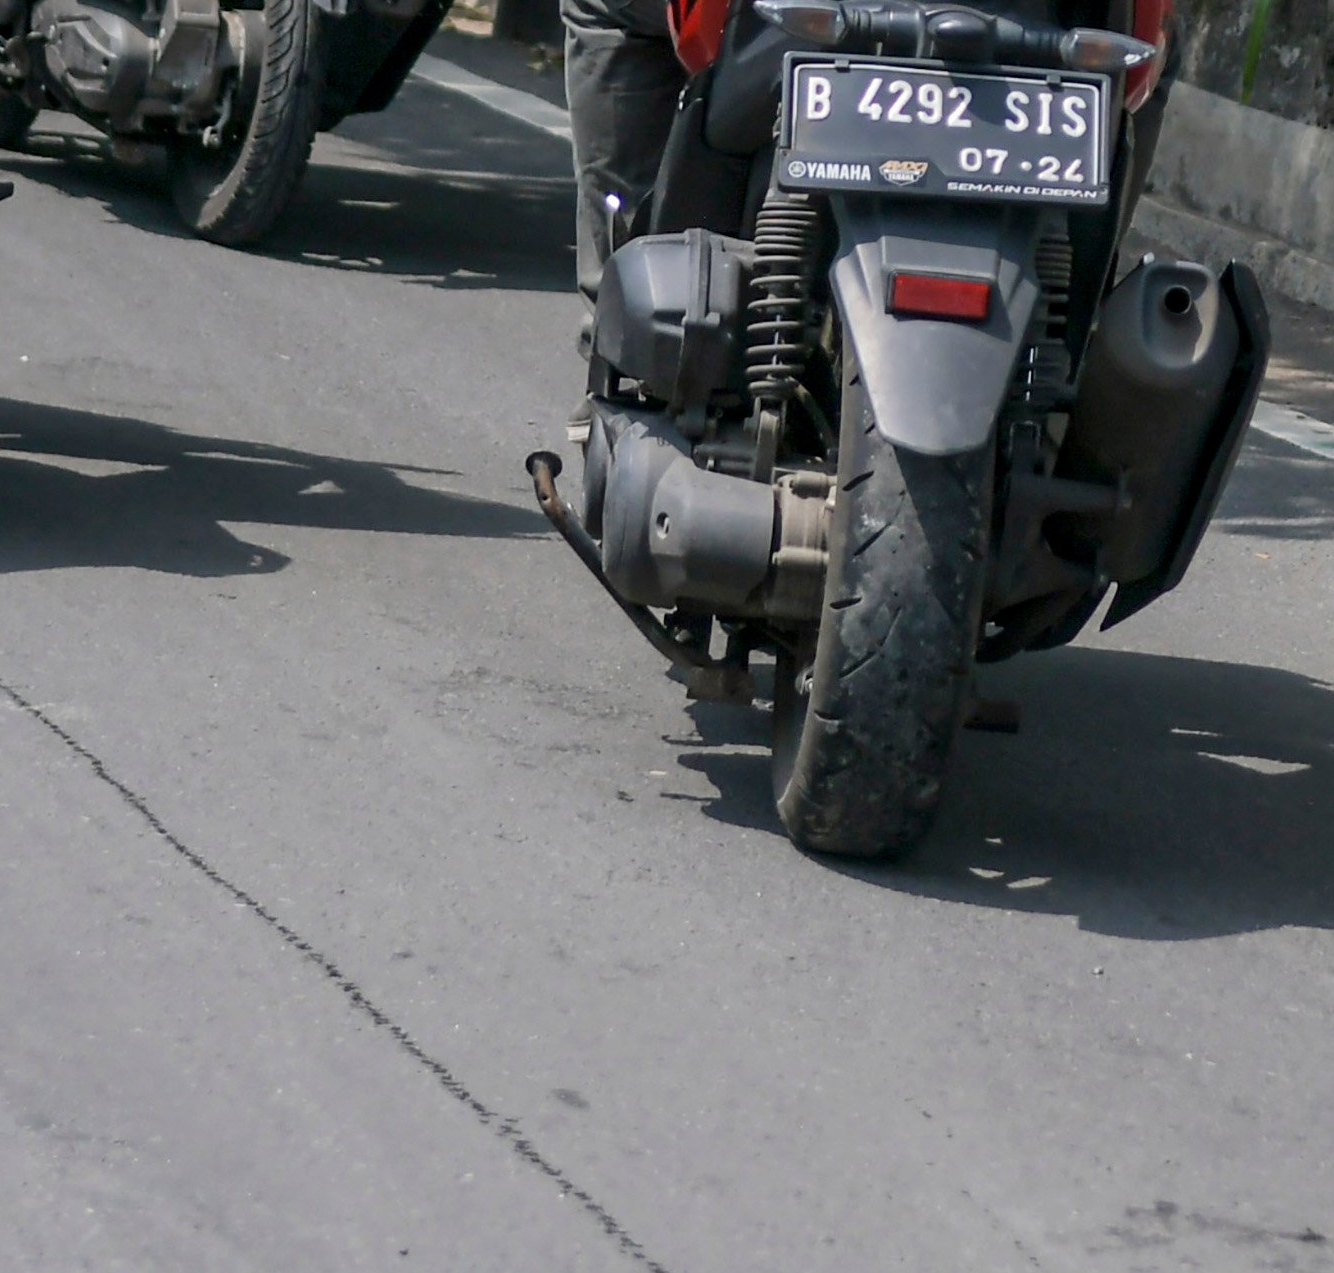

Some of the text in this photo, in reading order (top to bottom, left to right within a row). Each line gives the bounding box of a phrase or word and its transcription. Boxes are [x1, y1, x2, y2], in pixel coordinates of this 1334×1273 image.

[806, 76, 1087, 138] B 4292 SIS
[807, 162, 871, 182] YAMAHA
[1041, 187, 1097, 199] DEPAN
